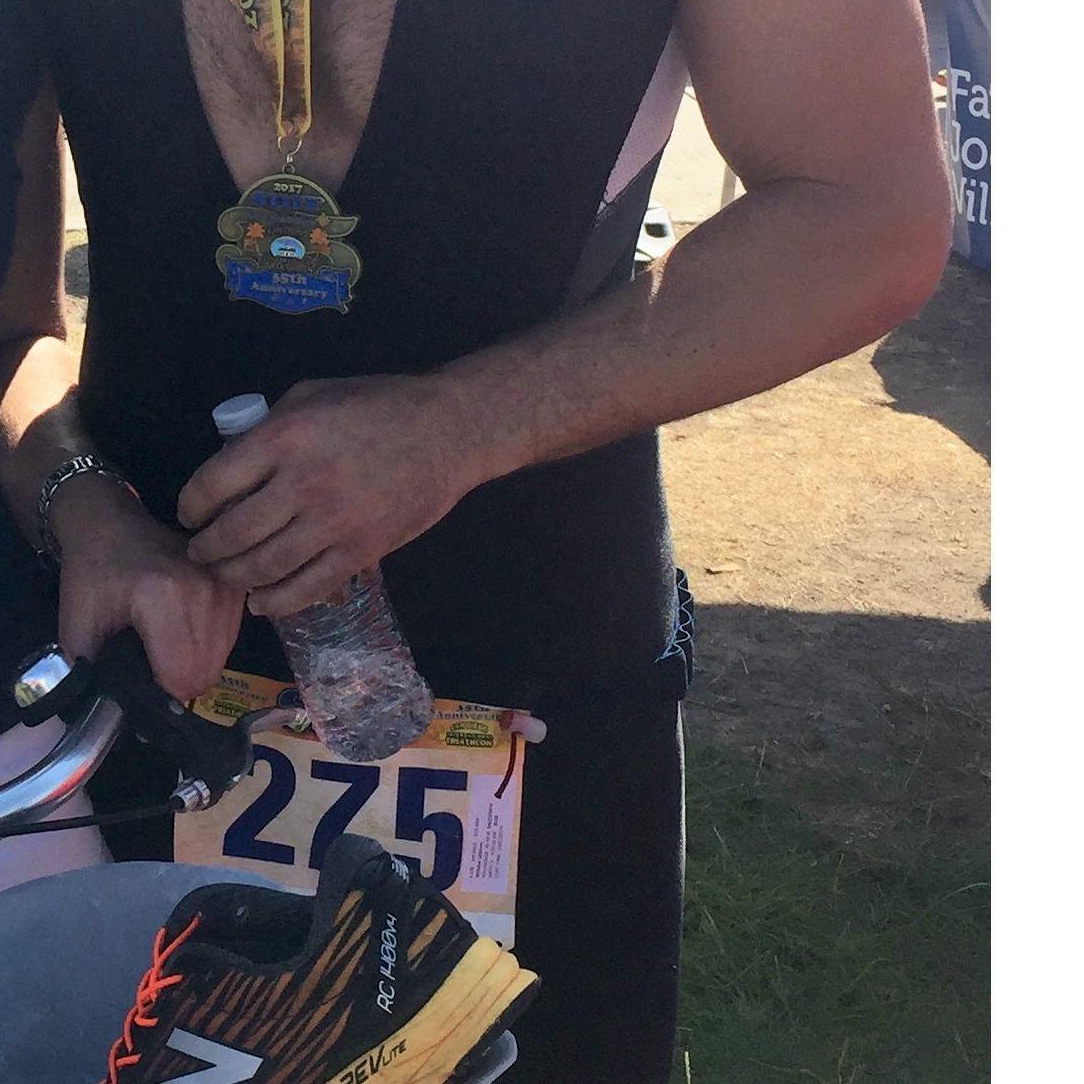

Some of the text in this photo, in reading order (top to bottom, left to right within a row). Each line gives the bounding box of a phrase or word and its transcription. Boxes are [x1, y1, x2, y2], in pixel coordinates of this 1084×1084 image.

[951, 68, 991, 120] Fa
[951, 119, 991, 171] Jo
[273, 182, 304, 195] 2017
[222, 744, 468, 892] 275
